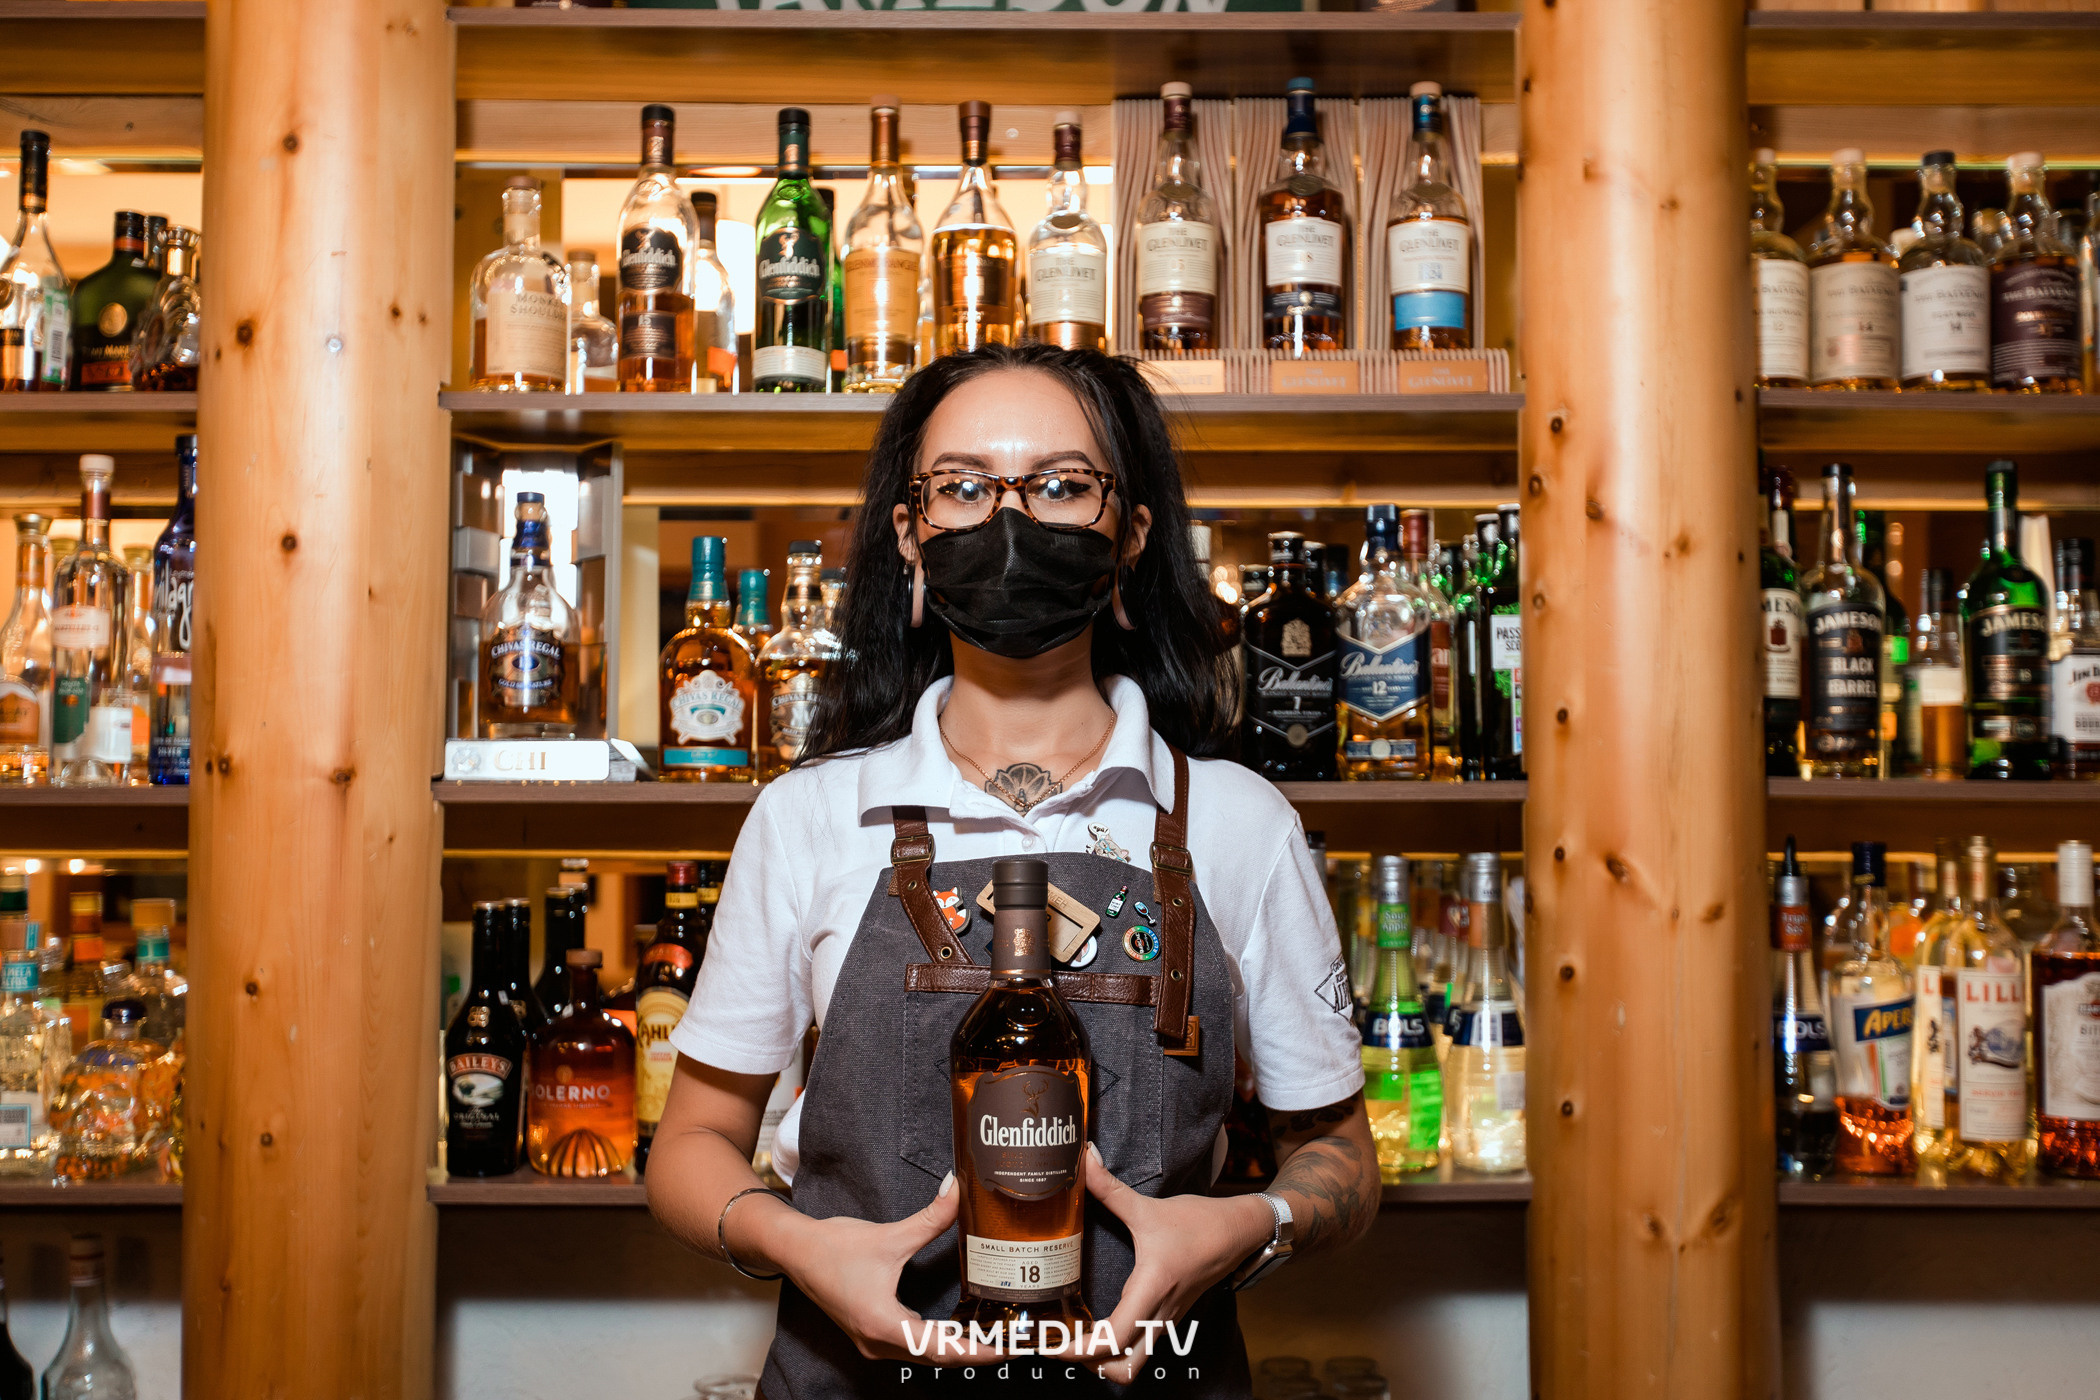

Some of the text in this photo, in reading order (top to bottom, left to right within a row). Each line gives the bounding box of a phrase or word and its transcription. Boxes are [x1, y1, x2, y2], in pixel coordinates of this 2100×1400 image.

[448, 1055, 509, 1073] BAILEYS
[532, 1084, 610, 1101] OLERNO
[980, 1114, 1076, 1147] Glenfiddich
[980, 1242, 1006, 1253] SMALL
[1043, 1241, 1074, 1252] RESERVE
[1019, 1265, 1041, 1284] 18
